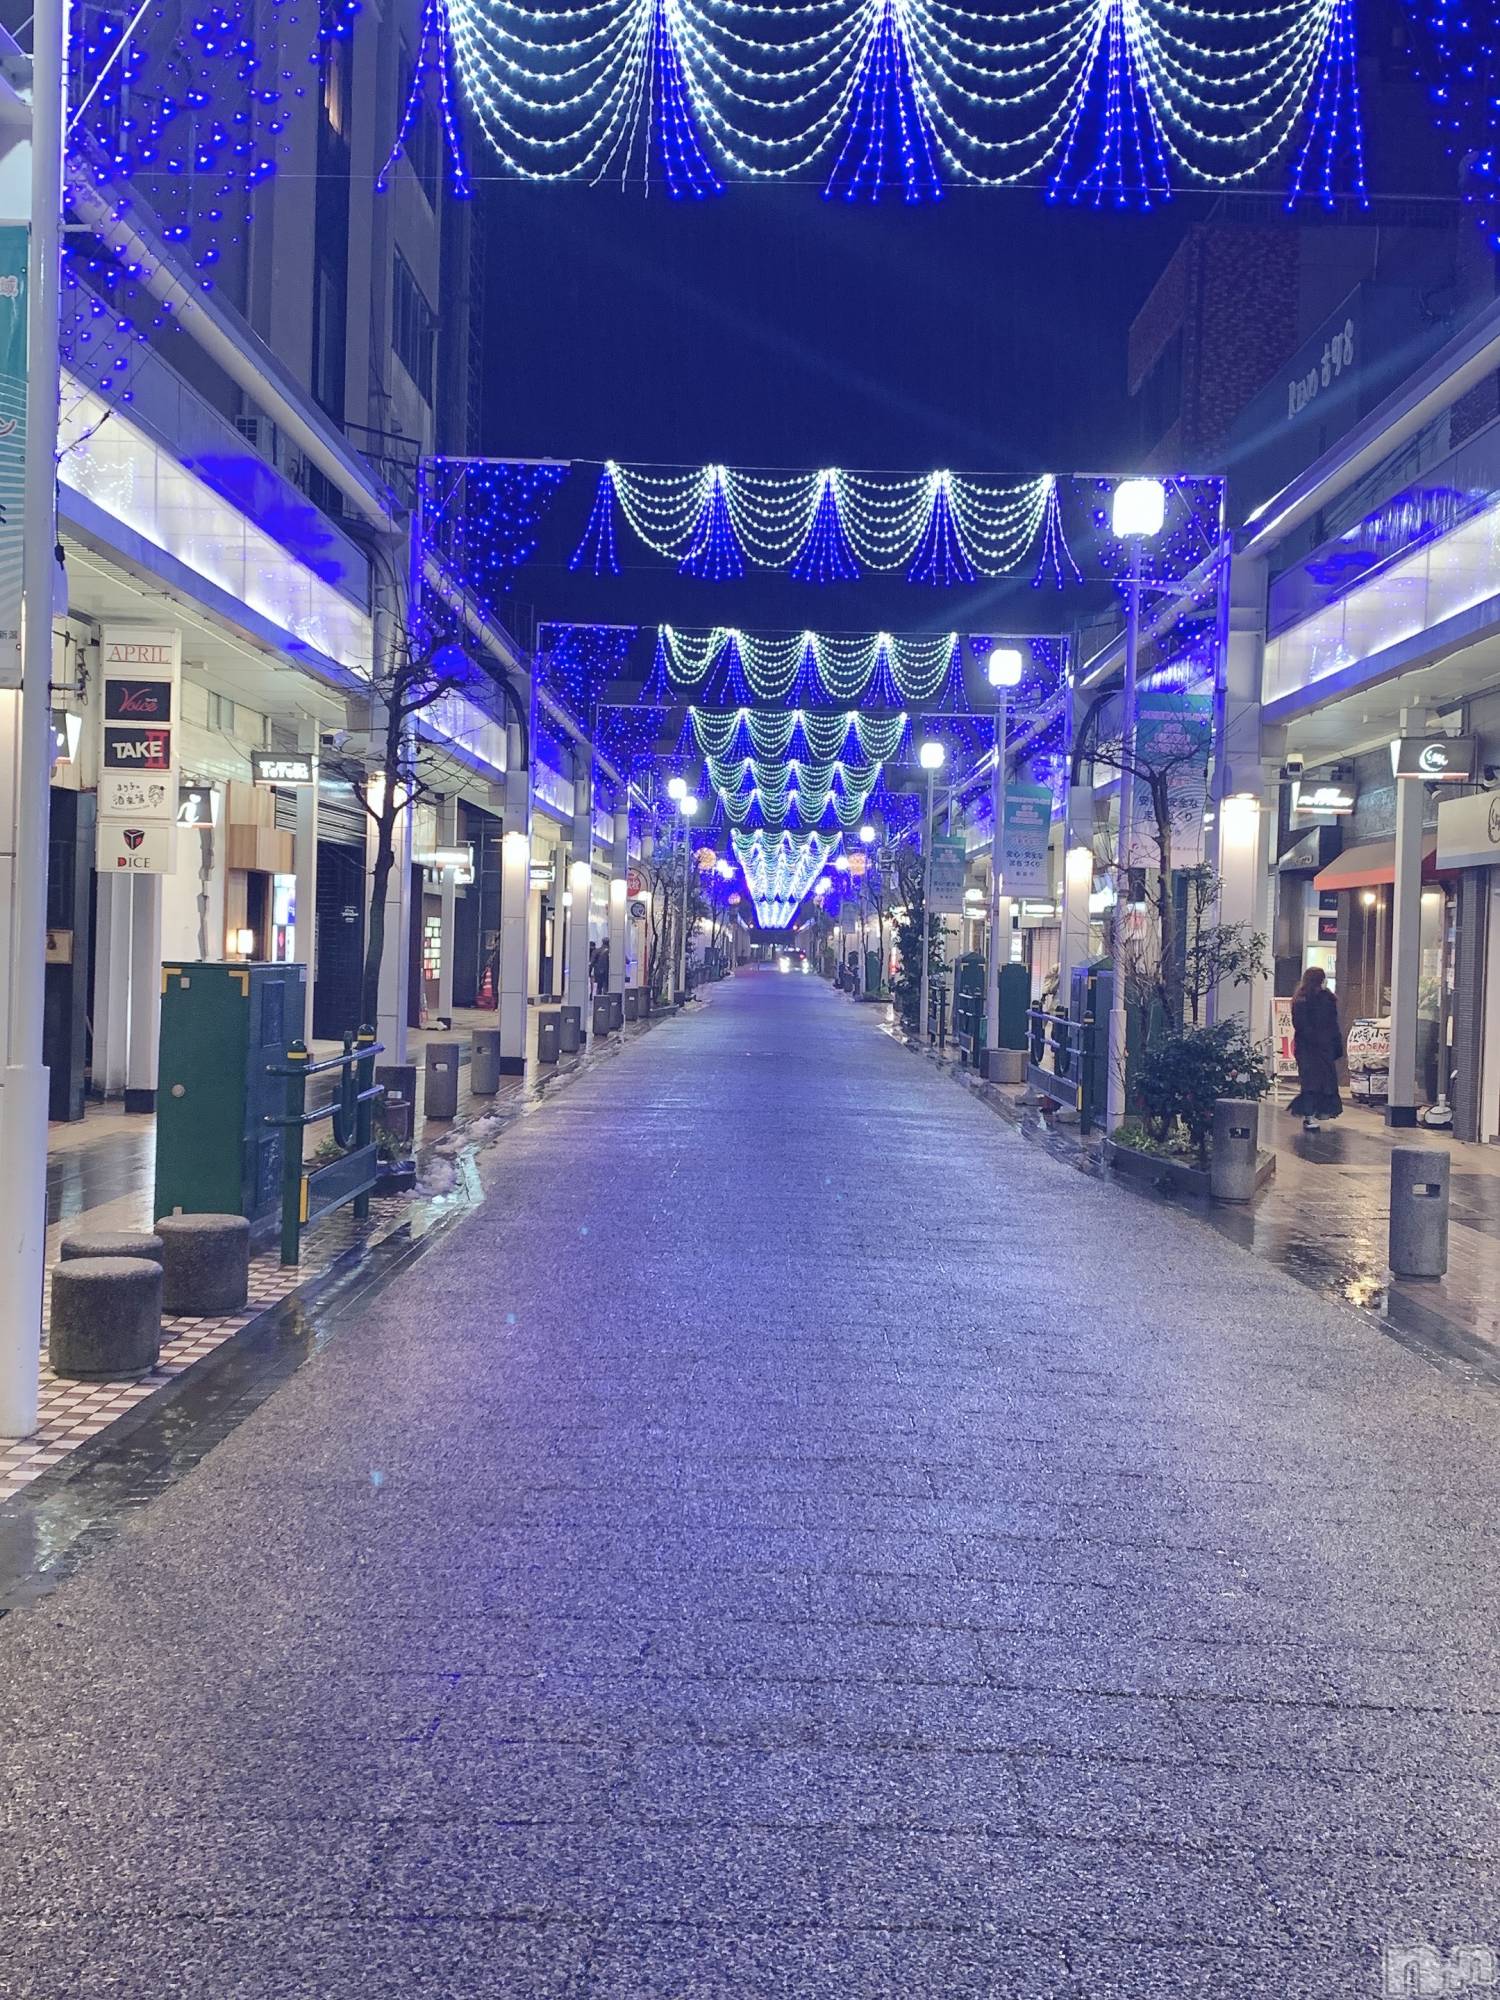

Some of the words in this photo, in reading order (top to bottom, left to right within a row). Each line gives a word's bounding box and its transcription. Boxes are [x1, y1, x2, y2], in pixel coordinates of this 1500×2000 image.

[110, 645, 169, 663] APRIL
[119, 688, 158, 712] Voice
[112, 741, 163, 759] TAKE
[117, 857, 150, 868] DICE
